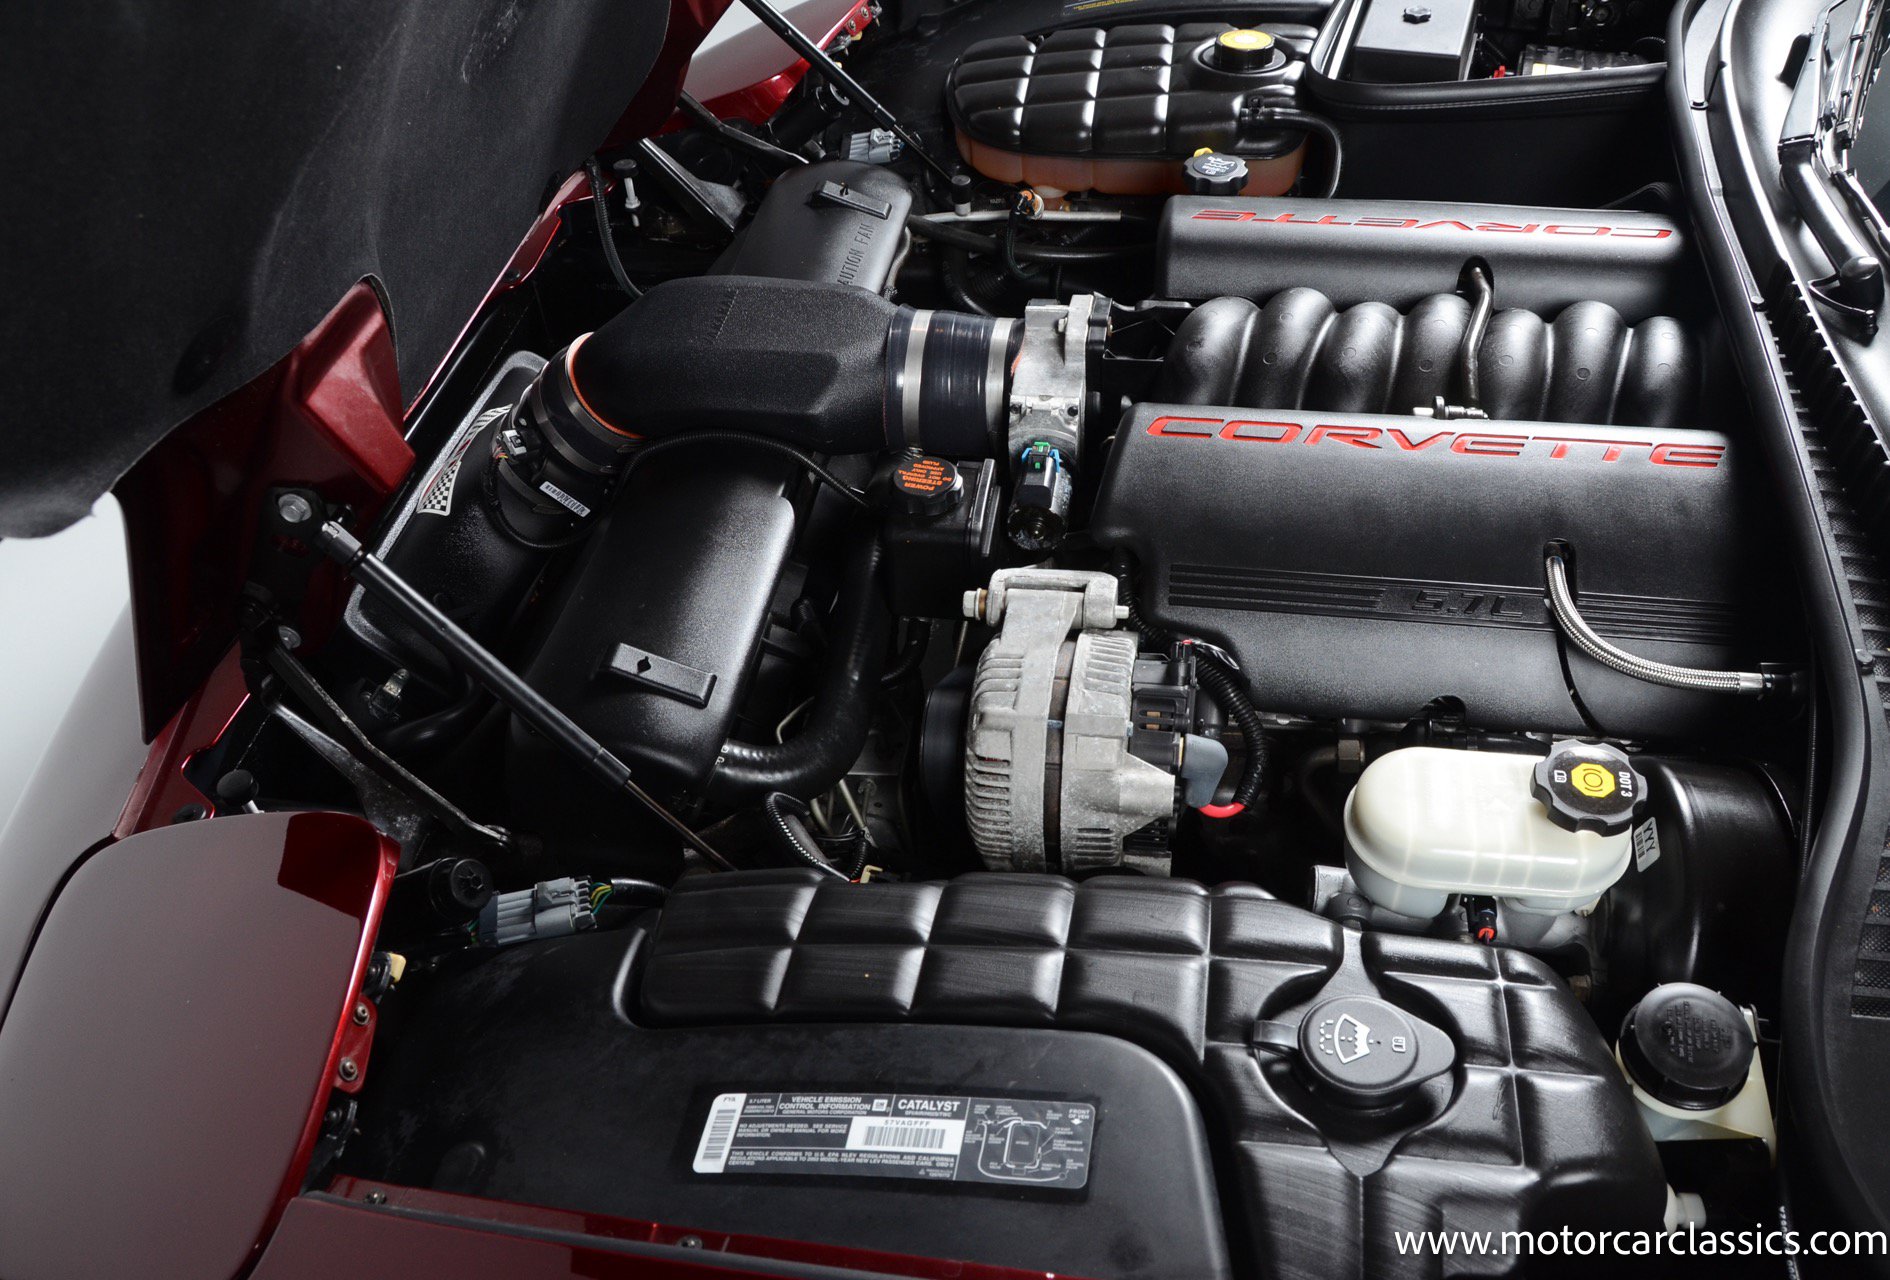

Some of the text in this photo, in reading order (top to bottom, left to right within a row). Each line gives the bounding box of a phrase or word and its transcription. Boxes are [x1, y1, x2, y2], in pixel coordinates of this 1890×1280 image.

[1191, 209, 1673, 239] CORVETTE
[836, 223, 875, 286] AUTION FAN
[1146, 415, 1726, 469] CORVETTE
[902, 475, 943, 486] STEERING
[904, 482, 935, 491] POWER
[1411, 590, 1523, 618] 5.7L
[1618, 771, 1633, 798] DOT 3
[1643, 821, 1656, 853] YYY
[817, 1103, 871, 1111] INFORMATION
[824, 1096, 862, 1104] EMISSION
[897, 1099, 961, 1112] CATALYST
